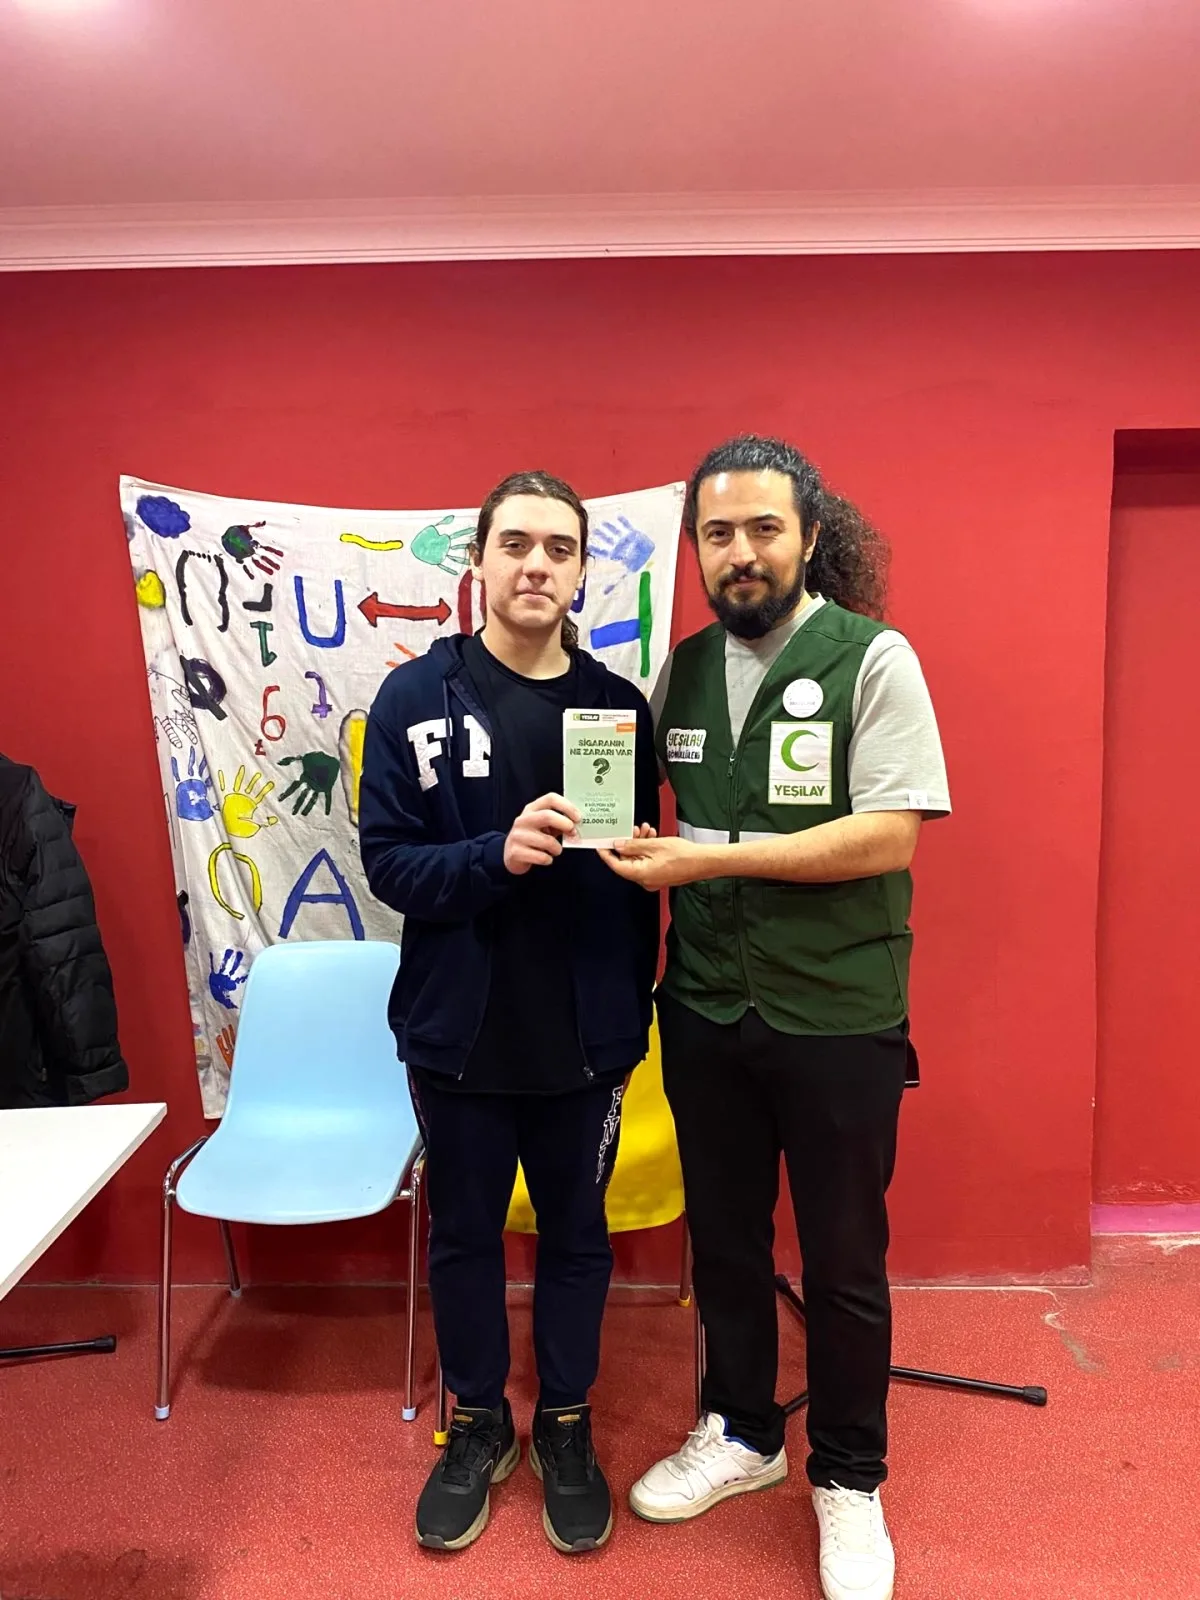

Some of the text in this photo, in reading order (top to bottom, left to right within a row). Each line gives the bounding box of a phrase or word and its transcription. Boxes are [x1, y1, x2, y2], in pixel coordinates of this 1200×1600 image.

[578, 738, 625, 748] SİGARANIN
[570, 748, 633, 757] NE ZARARI VAR
[774, 784, 826, 798] YEŞİLAY
